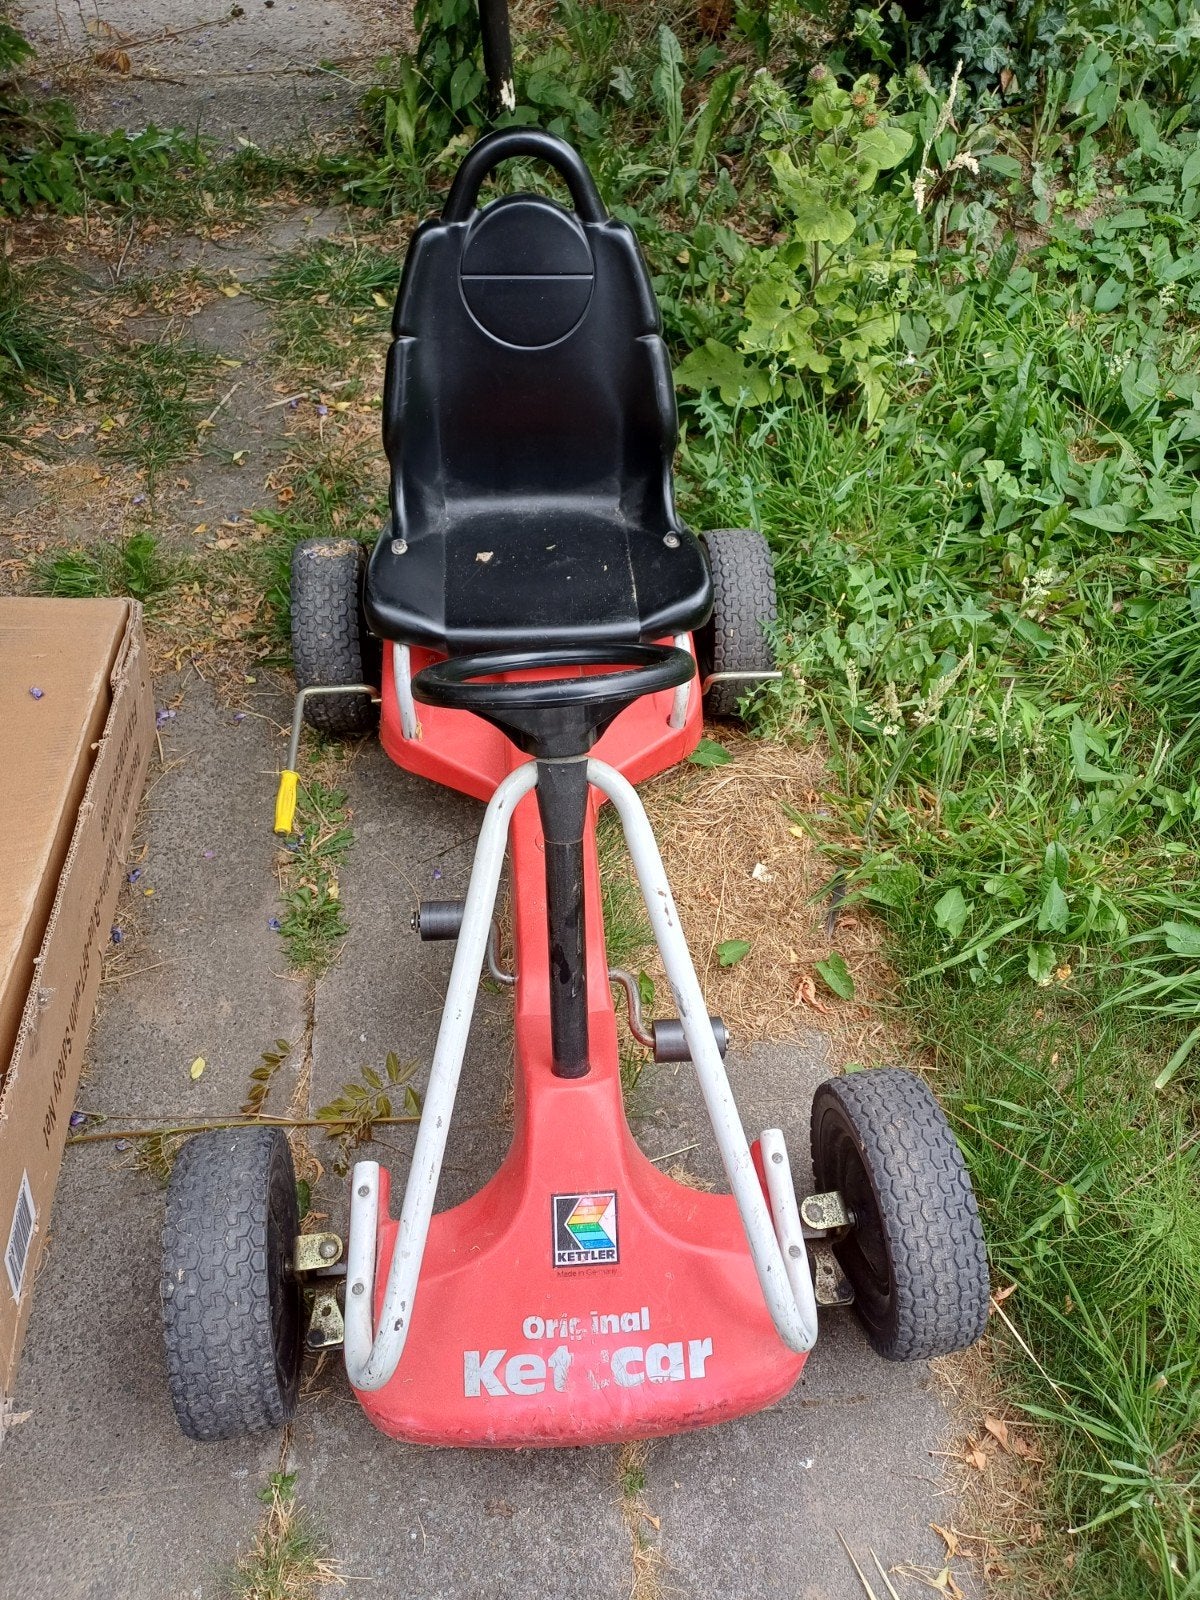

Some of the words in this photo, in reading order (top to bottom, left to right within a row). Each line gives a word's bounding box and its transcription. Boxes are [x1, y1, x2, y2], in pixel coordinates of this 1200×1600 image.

[53, 1028, 73, 1096] Safety
[42, 1098, 57, 1150] Net
[557, 1249, 616, 1263] KETTLER
[463, 1337, 713, 1398] Ketcar
